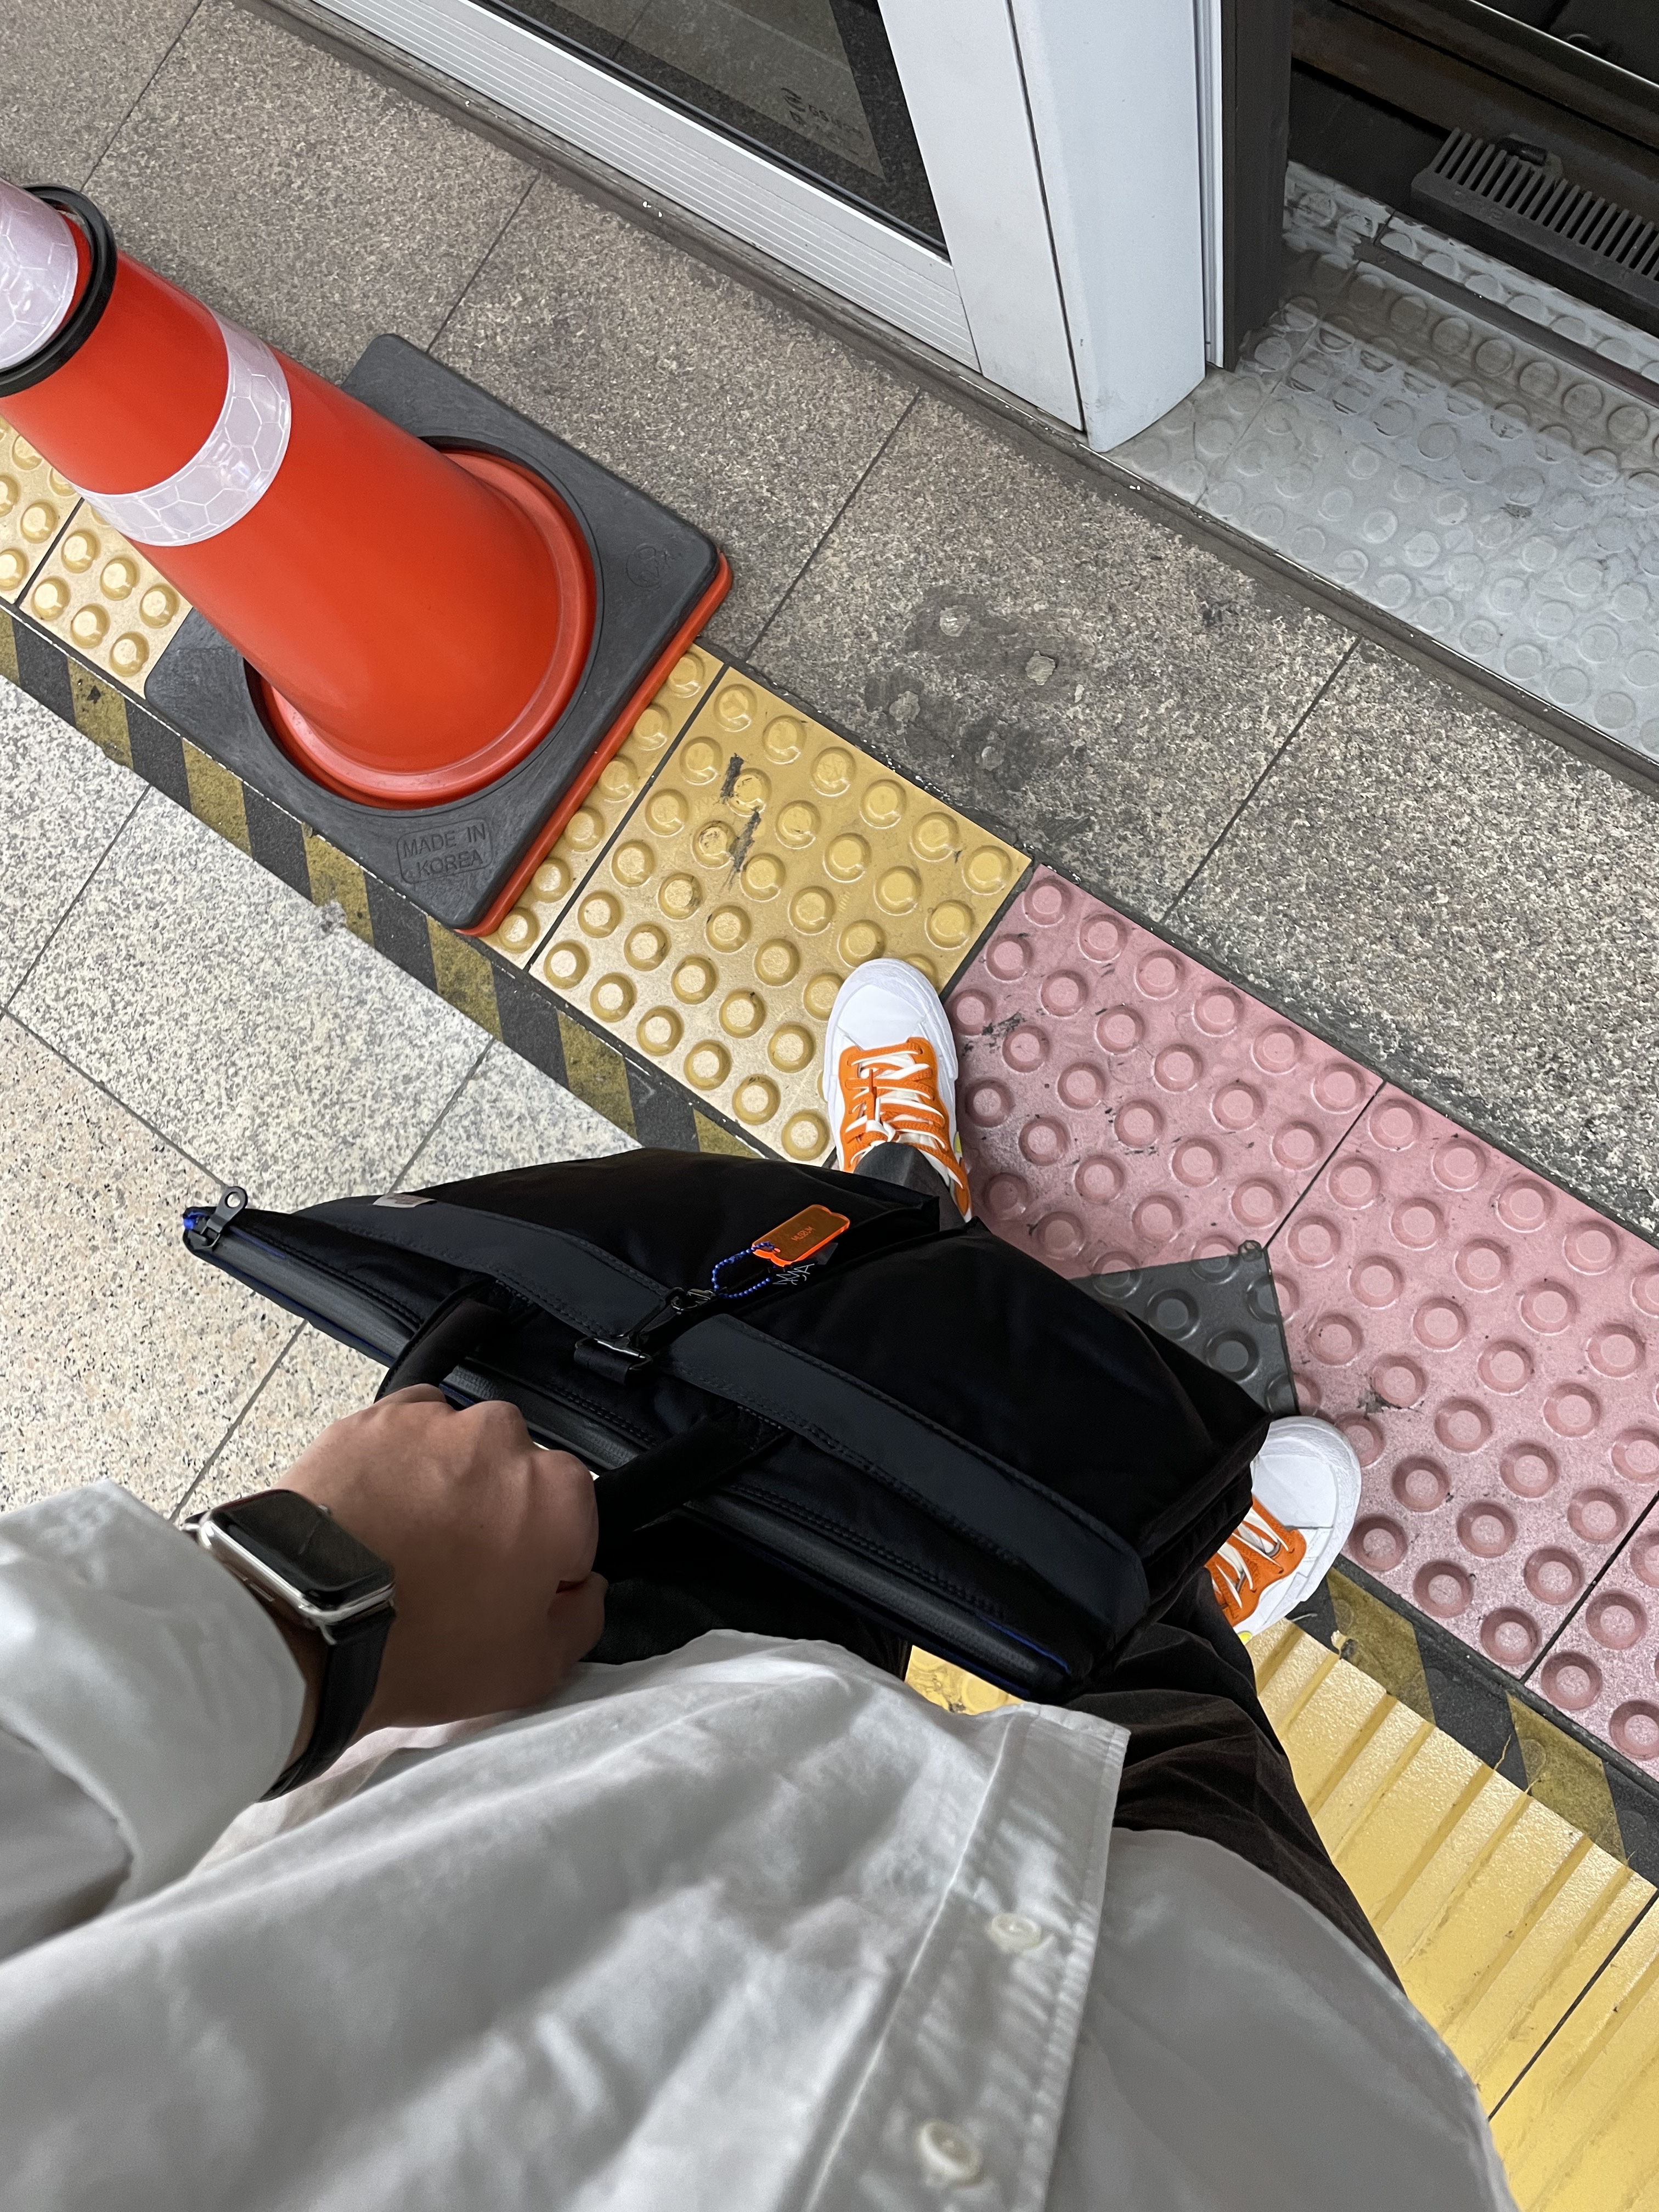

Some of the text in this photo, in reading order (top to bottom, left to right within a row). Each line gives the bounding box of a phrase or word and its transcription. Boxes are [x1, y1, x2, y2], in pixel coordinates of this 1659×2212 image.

[403, 823, 486, 857] MADE IN
[416, 849, 483, 878] KOREA
